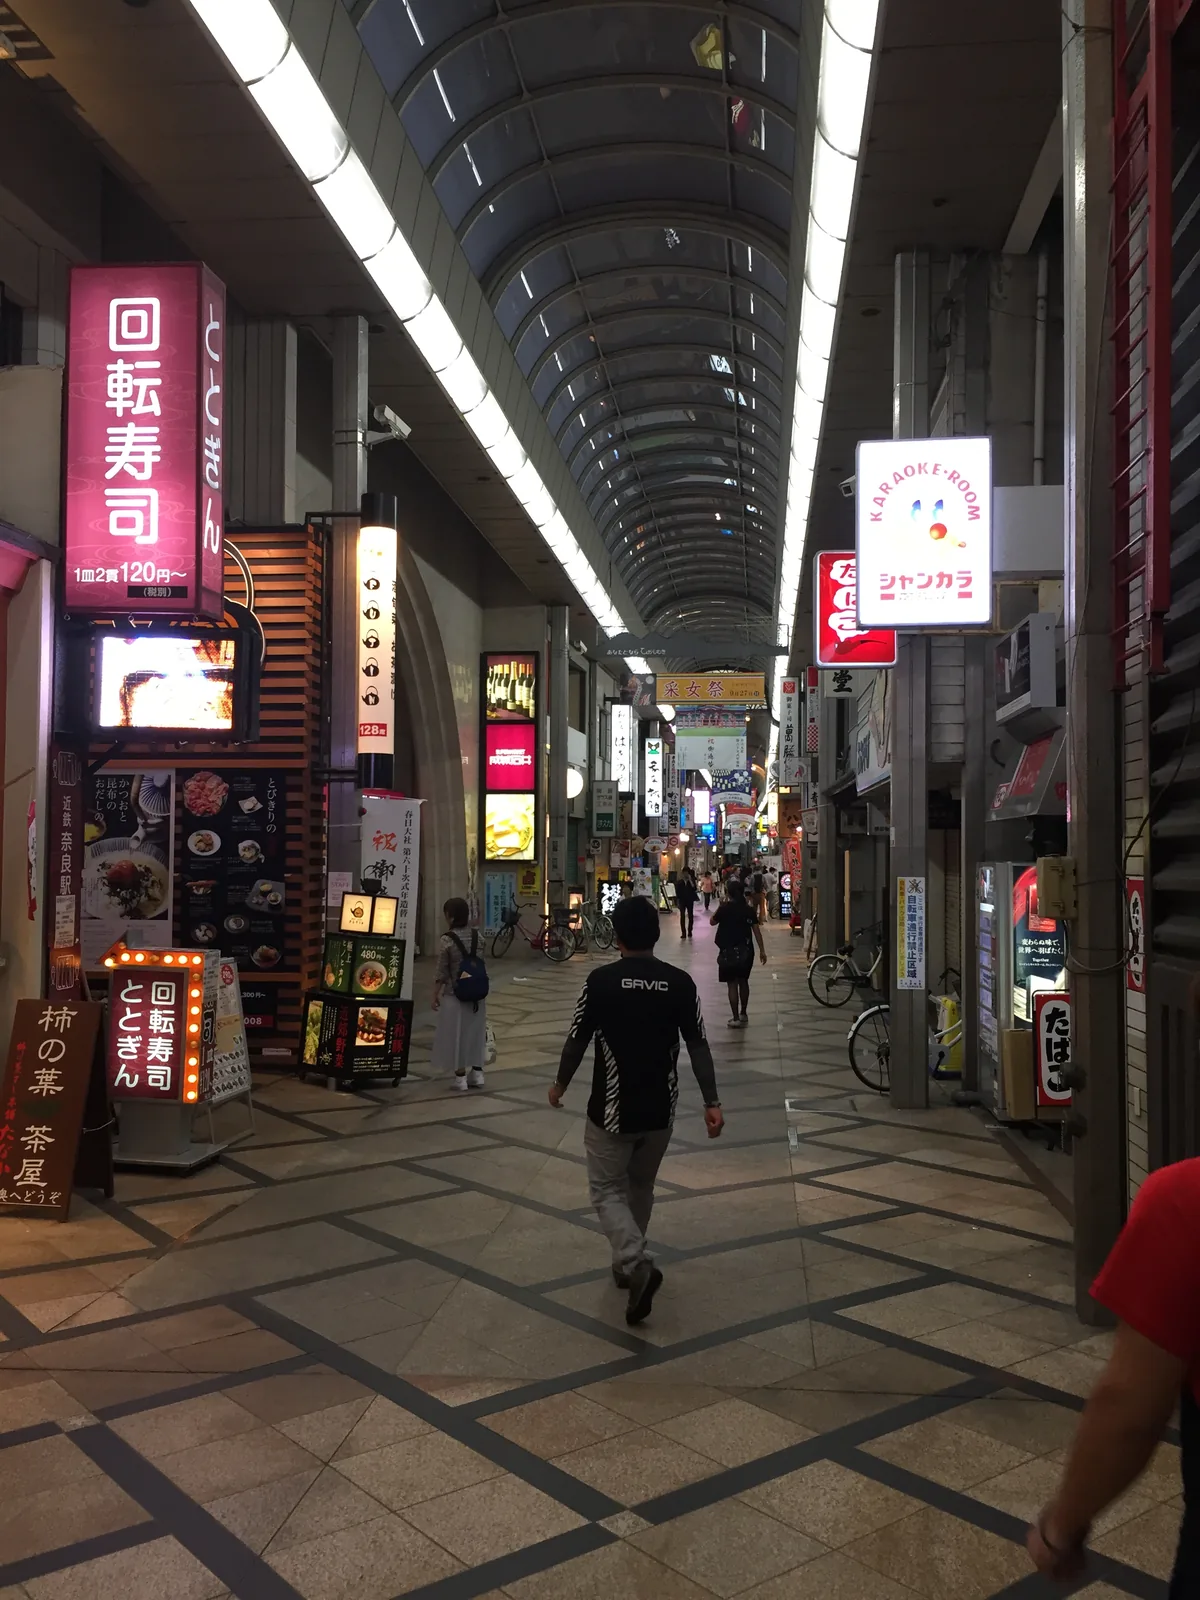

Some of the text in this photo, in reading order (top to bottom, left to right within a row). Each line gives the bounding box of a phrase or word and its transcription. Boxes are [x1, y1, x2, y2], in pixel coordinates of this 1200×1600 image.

[105, 297, 162, 545] 回転寿司
[204, 303, 221, 554] ととぎん
[663, 680, 725, 698] 采女祭
[107, 778, 117, 810] 昆布の
[119, 778, 130, 822] かつおと
[266, 777, 278, 834] とびきりの
[59, 795, 73, 895] 近鉄奈良駅
[387, 944, 401, 989] お茶漬け
[907, 895, 917, 978] 自転車通行禁止区域
[621, 978, 669, 992] GAVIC
[114, 979, 143, 1088] ととぎん
[147, 981, 176, 1091] 回転寿司
[13, 1006, 78, 1188] 柿の葉 茶屋
